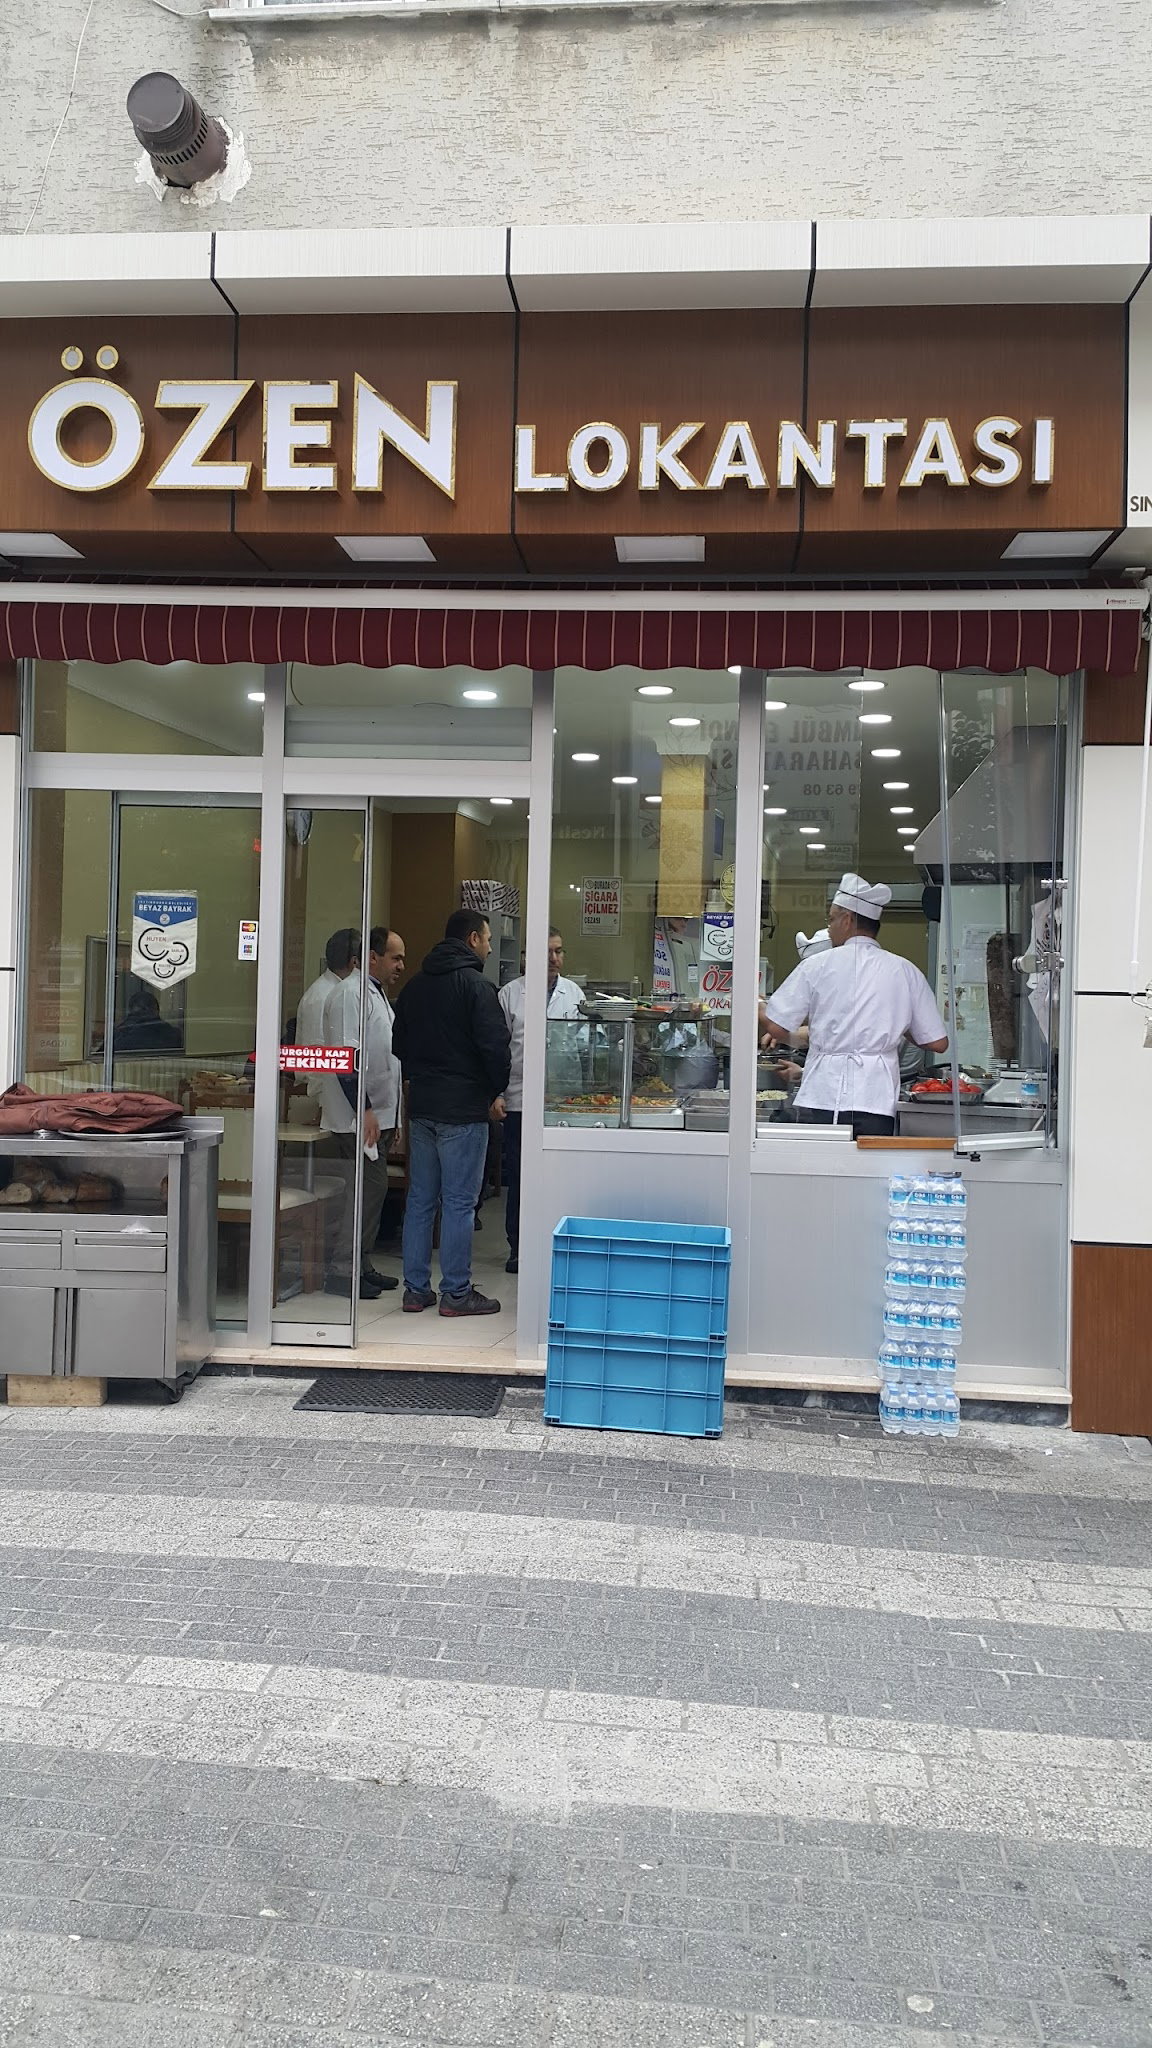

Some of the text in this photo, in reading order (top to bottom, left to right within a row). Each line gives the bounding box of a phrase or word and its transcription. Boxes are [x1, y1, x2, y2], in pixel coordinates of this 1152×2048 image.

[27, 344, 1055, 501] ÖZEN LOKANTASI
[585, 891, 618, 902] SİGARA
[138, 904, 161, 912] BEYAZ
[584, 902, 619, 915] İÇİLMEZ
[325, 1050, 349, 1058] KAPI
